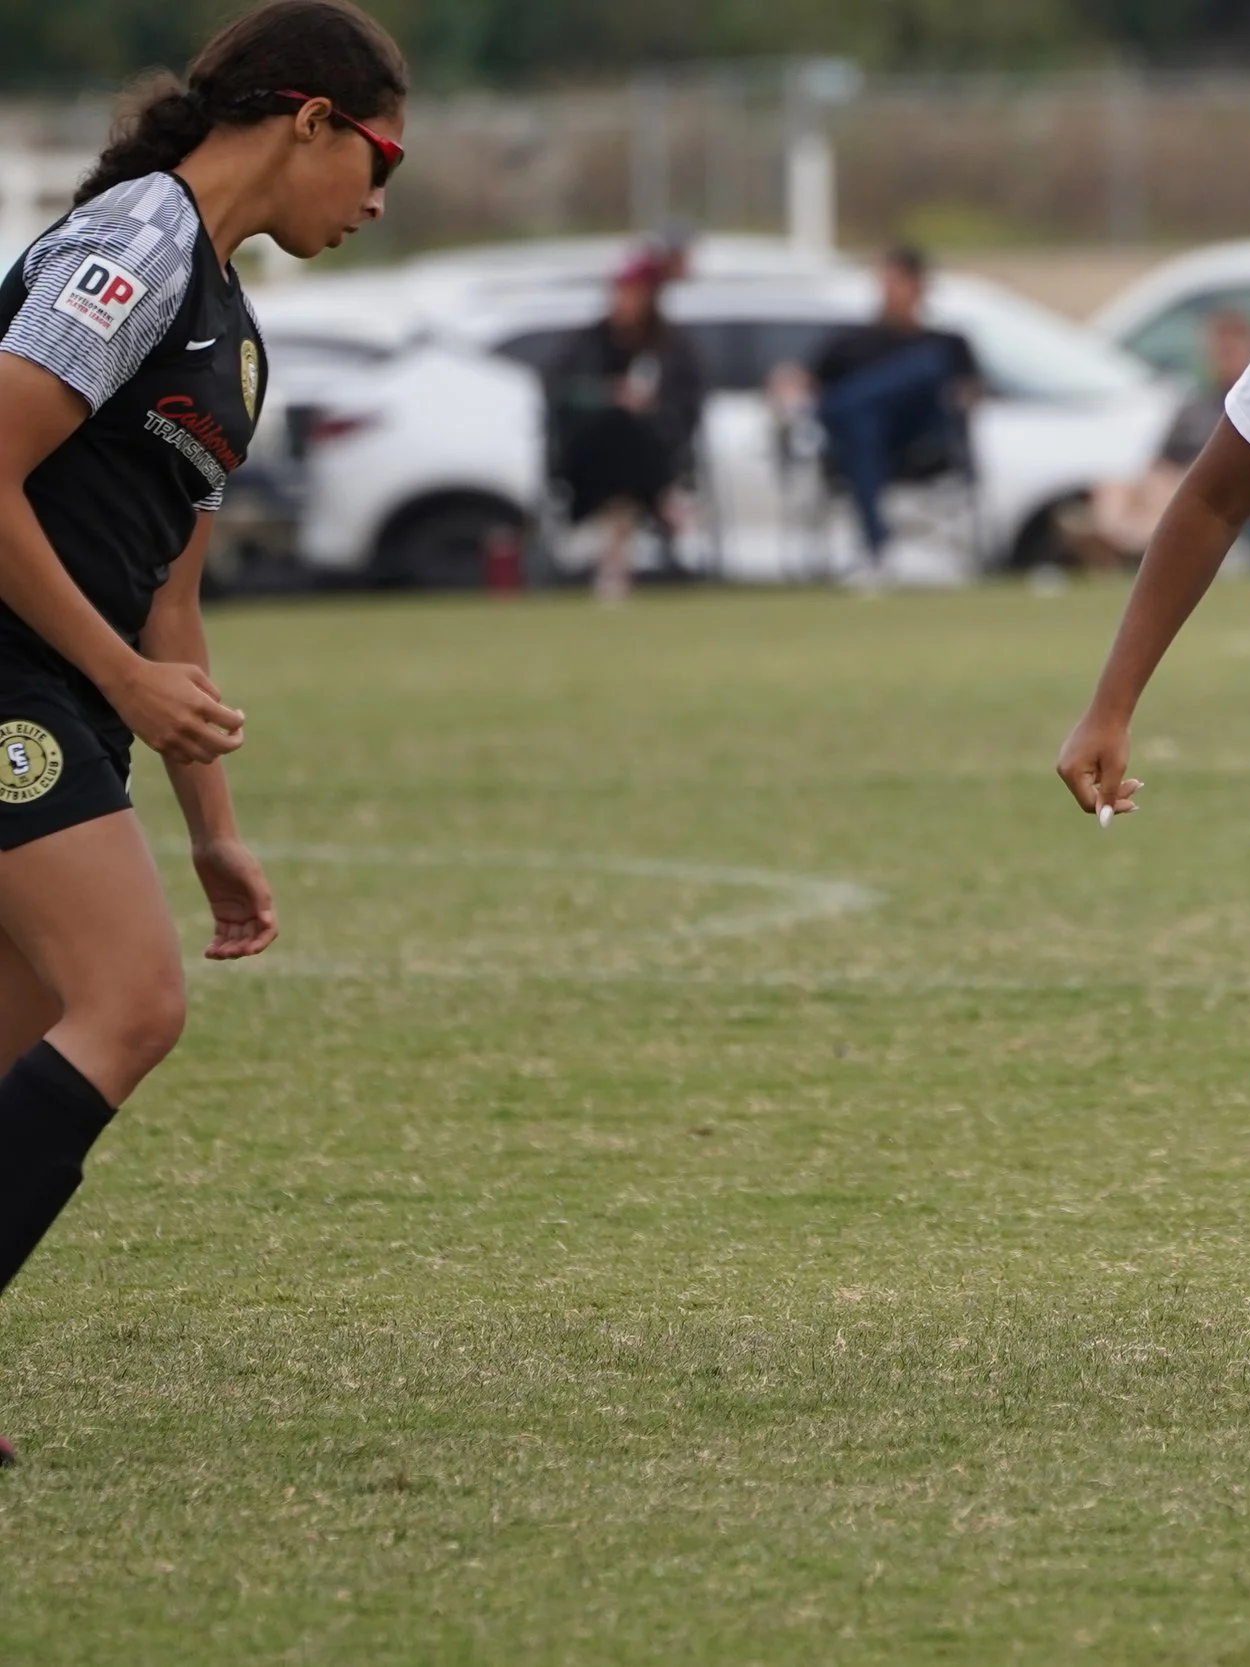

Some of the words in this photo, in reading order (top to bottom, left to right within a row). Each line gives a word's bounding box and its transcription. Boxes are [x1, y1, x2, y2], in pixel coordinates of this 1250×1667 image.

[76, 263, 134, 306] DP
[70, 292, 115, 323] DEVELOPMENT
[16, 724, 47, 742] ELITE
[40, 761, 59, 788] CLUB
